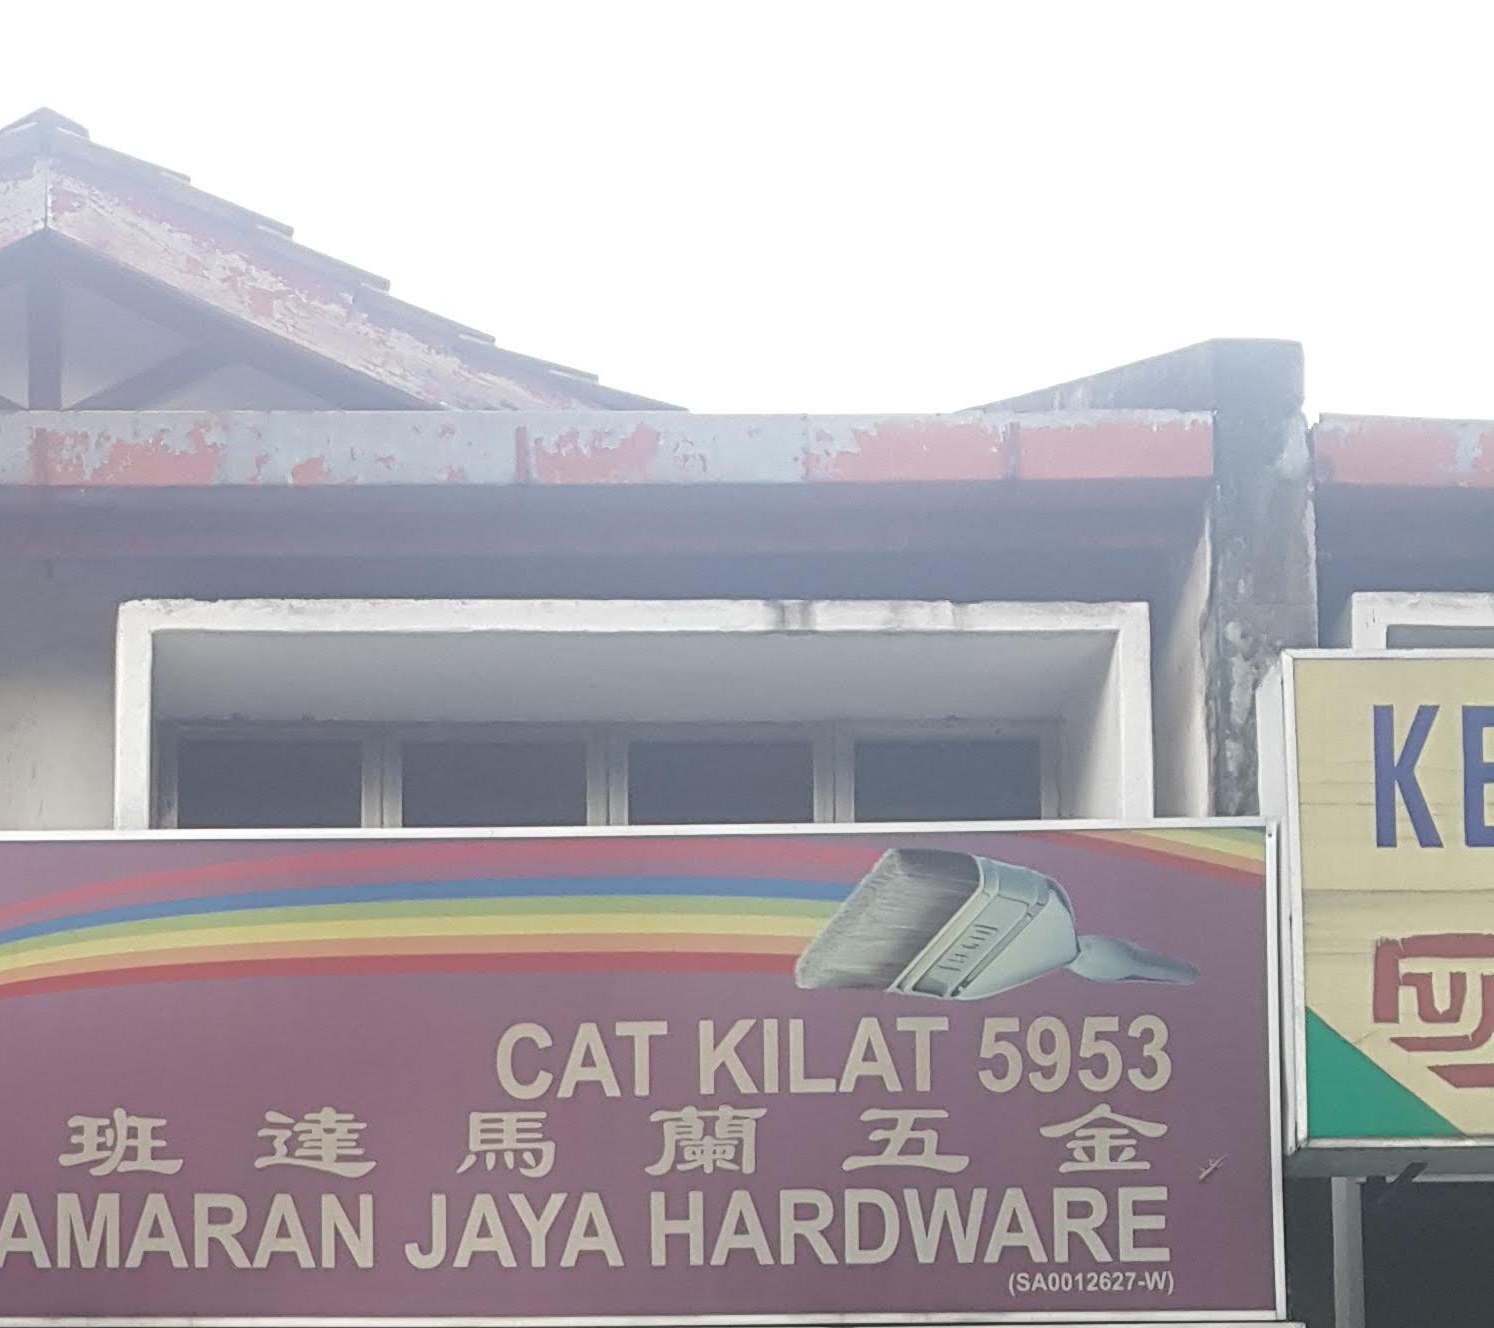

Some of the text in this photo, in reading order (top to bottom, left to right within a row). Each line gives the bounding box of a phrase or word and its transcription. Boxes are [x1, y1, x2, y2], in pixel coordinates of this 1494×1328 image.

[496, 1014, 1172, 1099] CAT KILAT 5953
[404, 1190, 624, 1270] JAYA
[650, 1187, 1171, 1268] HARDWARE
[1008, 1271, 1175, 1297] (SA0012627-W)
